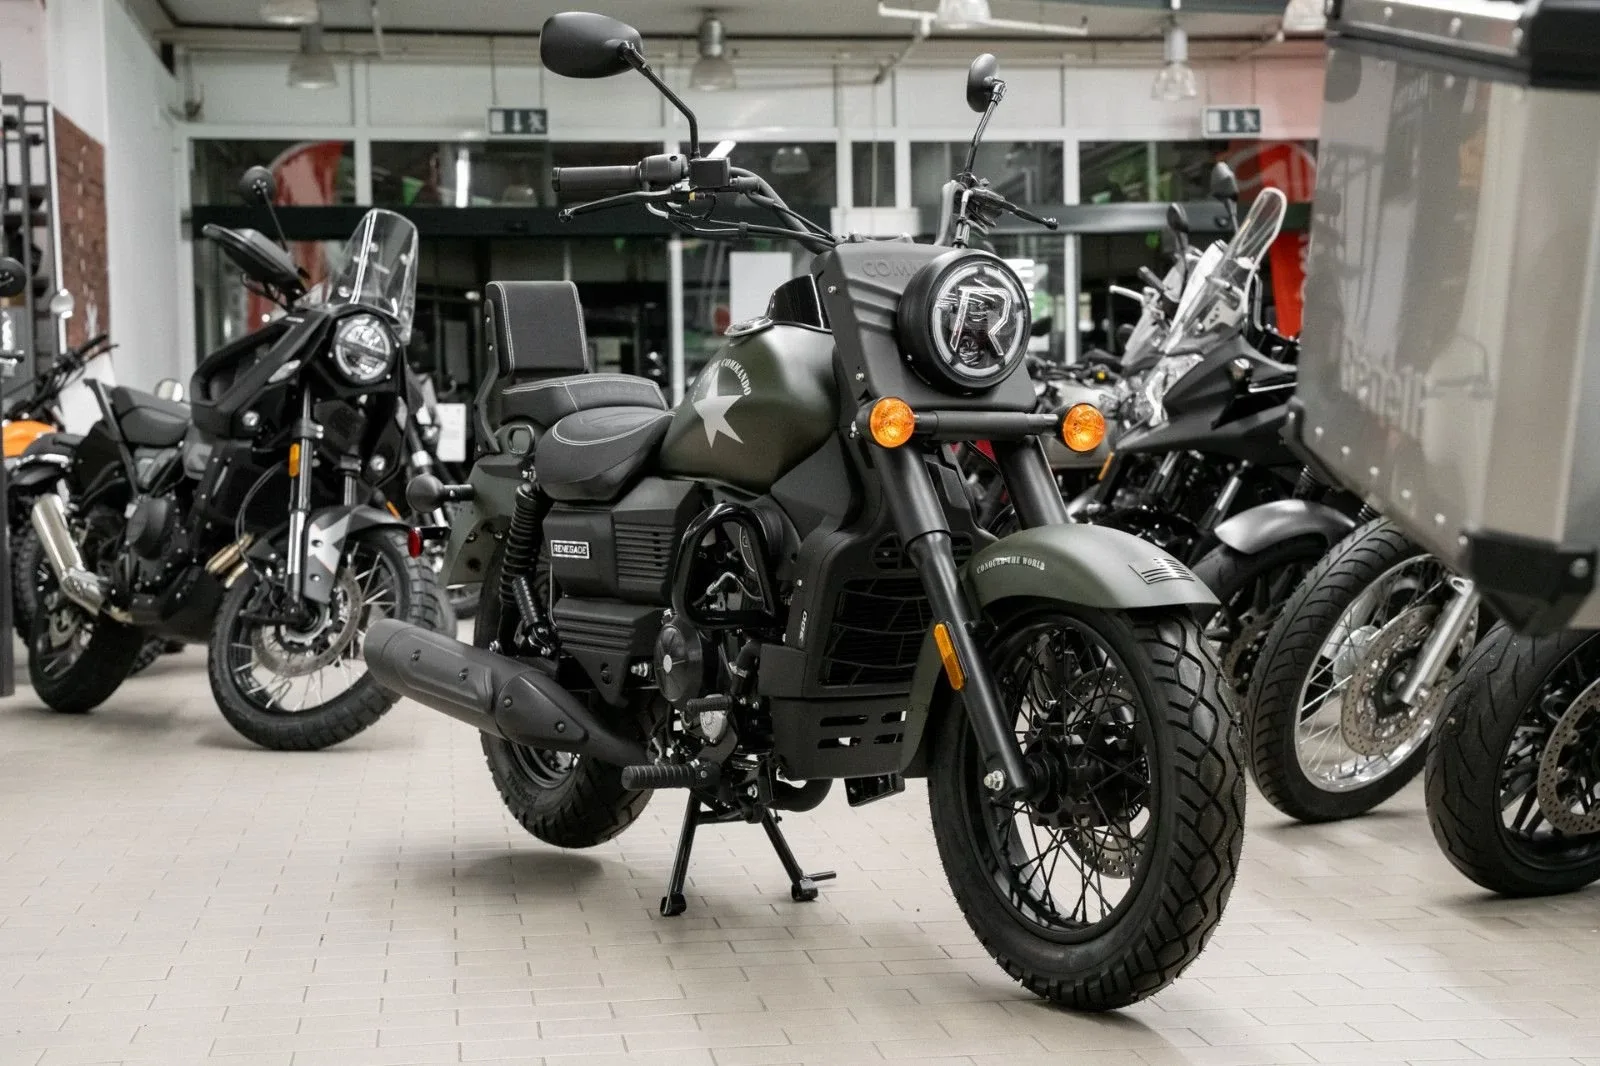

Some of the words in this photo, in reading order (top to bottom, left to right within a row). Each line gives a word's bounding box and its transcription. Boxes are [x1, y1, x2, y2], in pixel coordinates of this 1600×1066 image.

[720, 358, 752, 396] COMMANDO
[553, 543, 588, 555] RENEGADE
[1005, 556, 1021, 564] THE
[1022, 556, 1046, 571] WORLD
